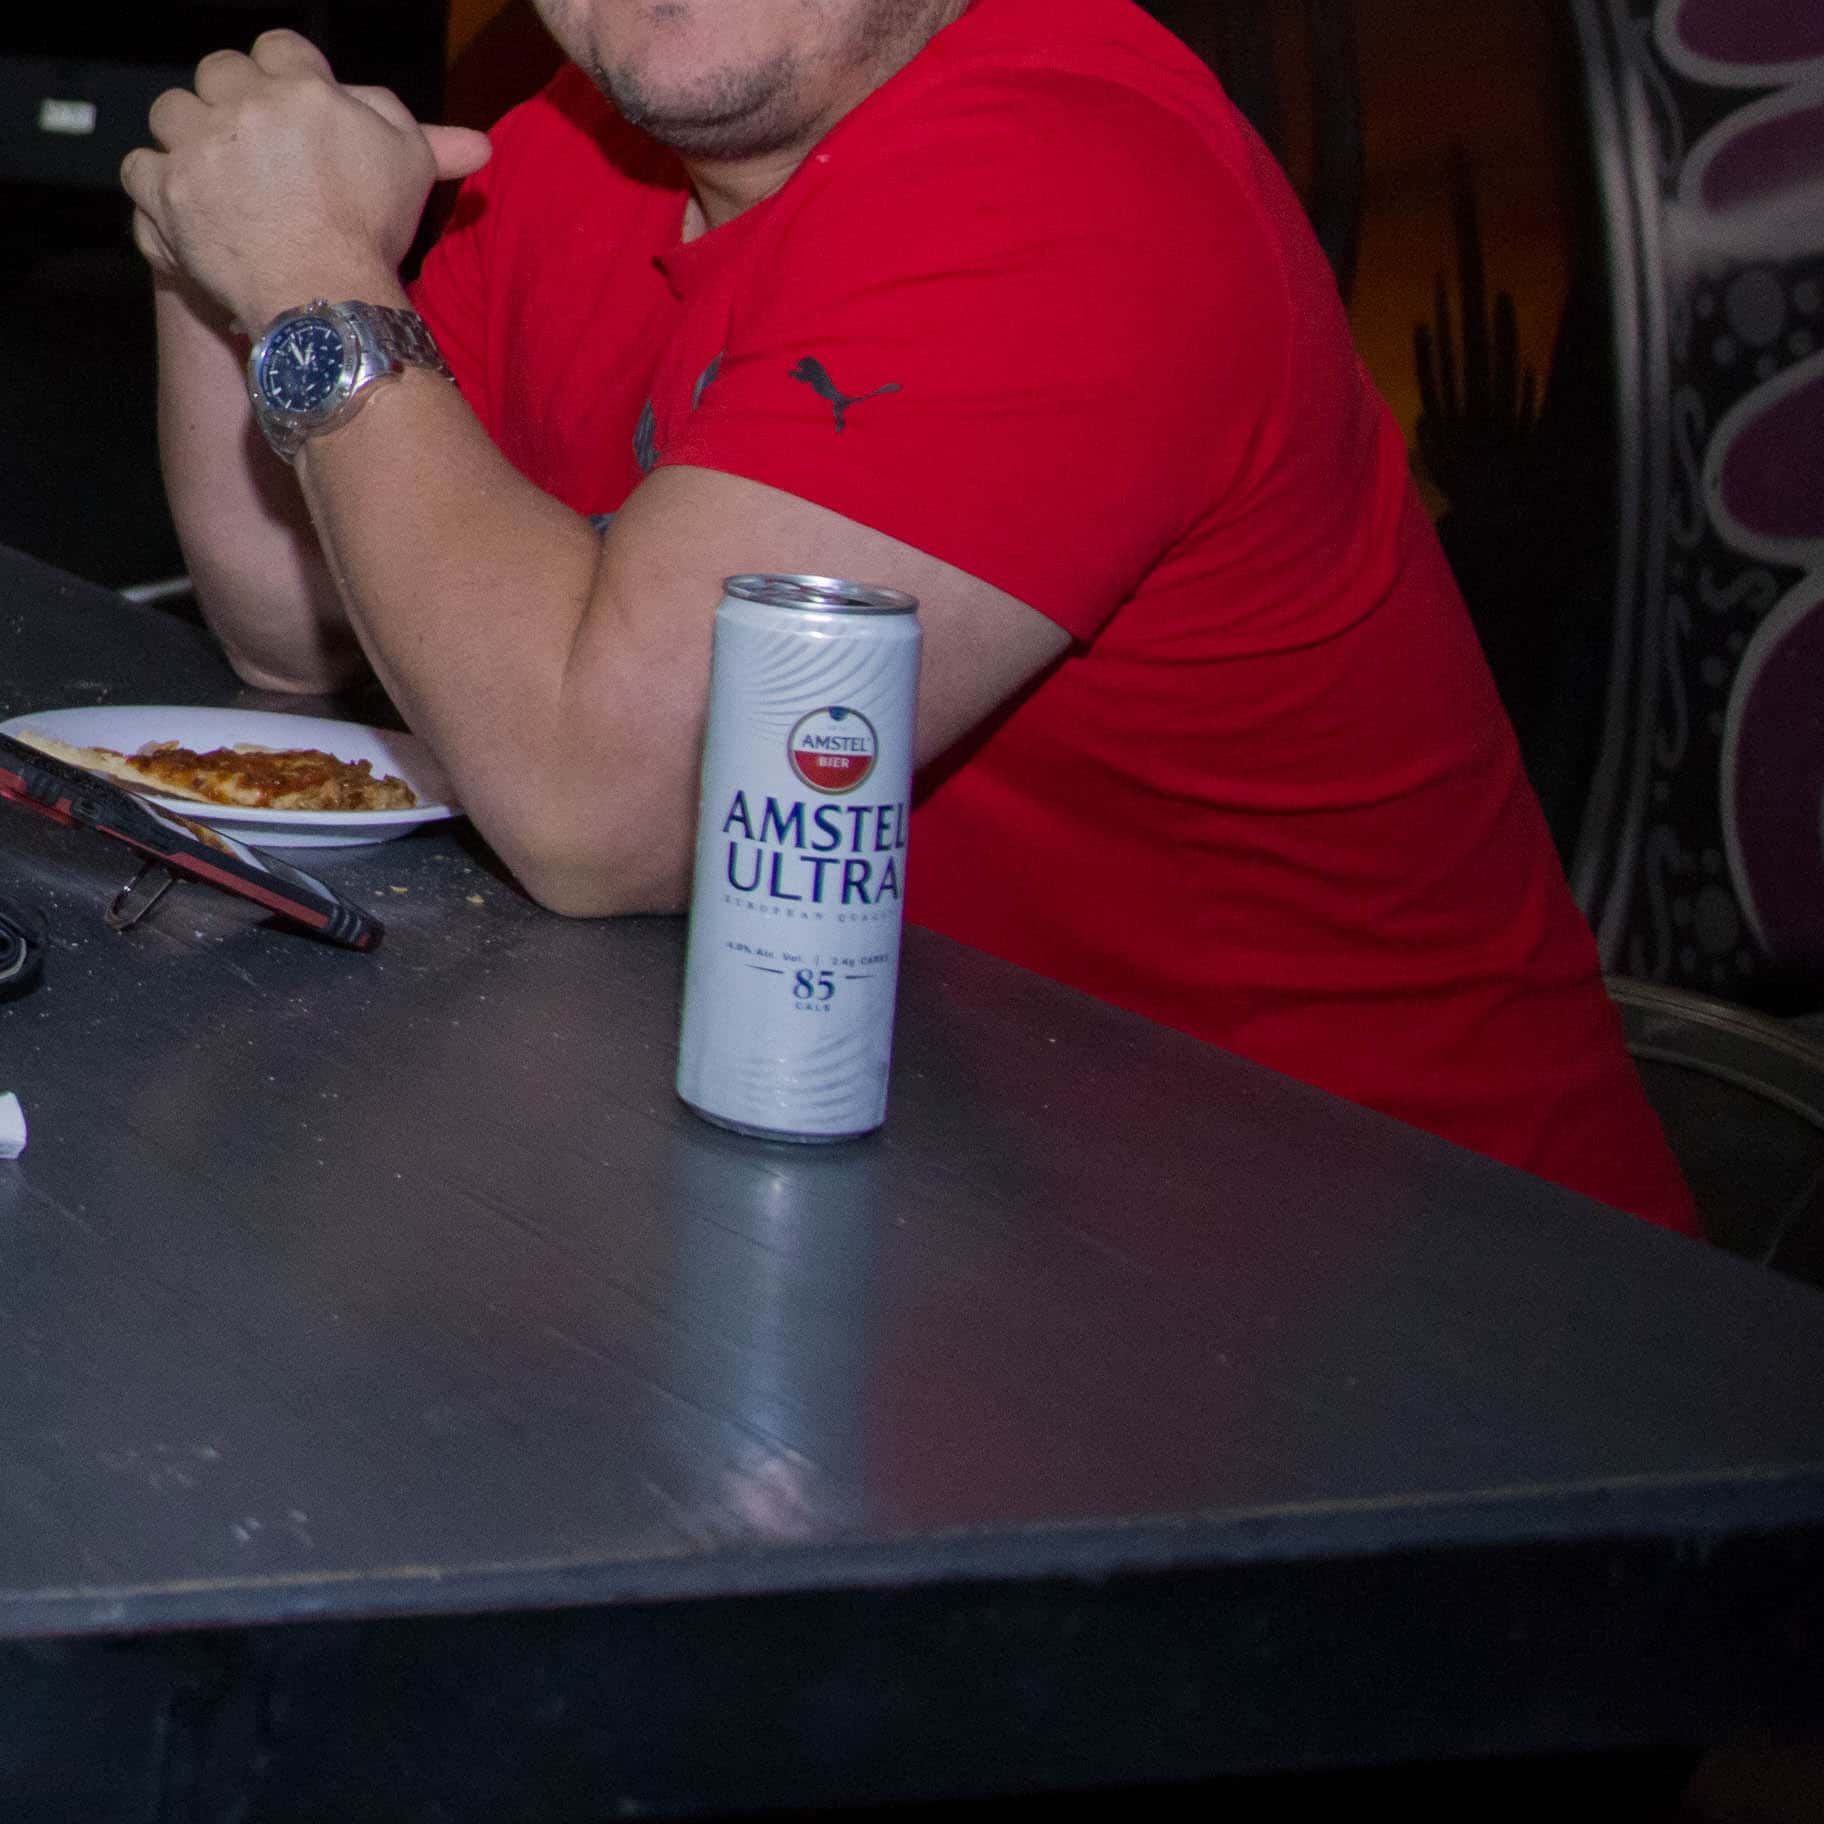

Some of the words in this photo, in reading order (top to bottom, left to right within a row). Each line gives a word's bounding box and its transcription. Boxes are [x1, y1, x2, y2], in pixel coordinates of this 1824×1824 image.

[801, 733, 869, 752] AMSTEL
[722, 789, 906, 853] AMSTEL
[726, 840, 900, 907] ULTRA
[792, 966, 837, 1002] 85
